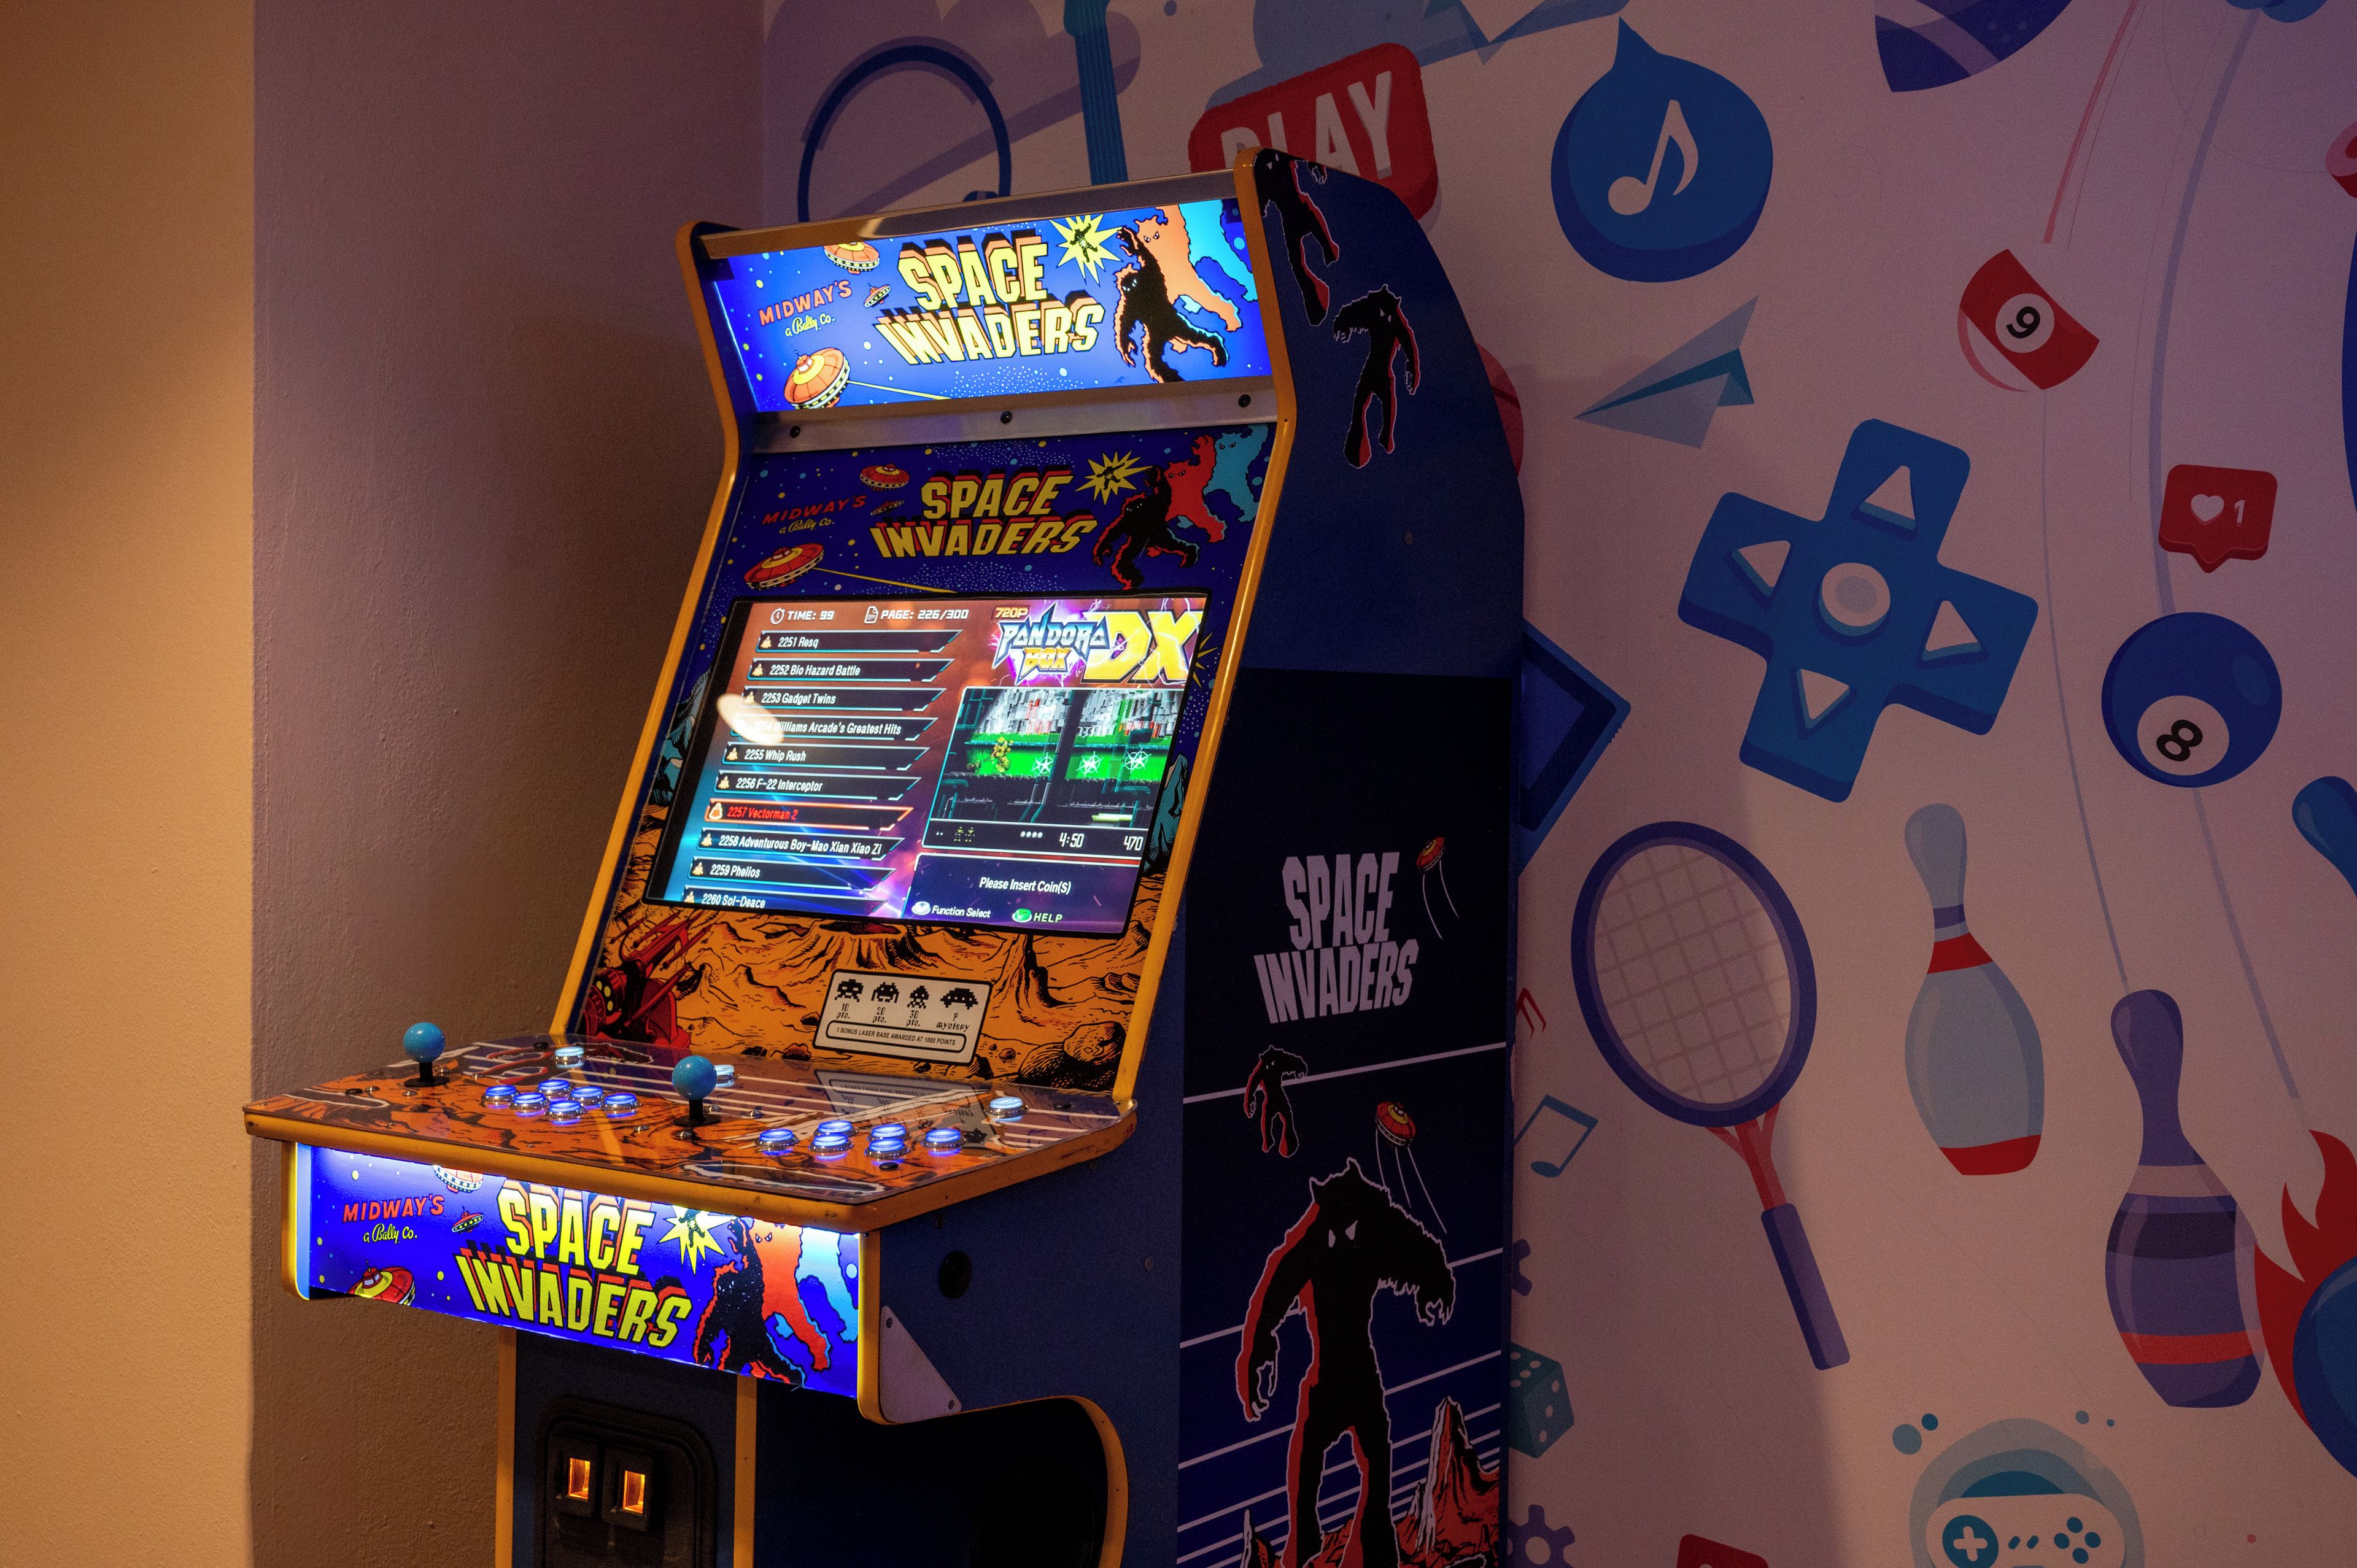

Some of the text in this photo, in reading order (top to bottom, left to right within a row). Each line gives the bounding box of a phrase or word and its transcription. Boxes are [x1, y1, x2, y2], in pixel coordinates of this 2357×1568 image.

[897, 238, 1048, 311] SPACE
[758, 279, 853, 326] MIDWAY'S
[785, 312, 835, 337] a Bally Co.
[872, 298, 1105, 365] INVADERS
[921, 473, 1072, 520] SPACE
[762, 495, 867, 525] MIDWAY'S
[788, 519, 817, 533] Bally
[869, 516, 1097, 558] INVADERS
[788, 610, 835, 620] TIME: 99
[881, 609, 969, 620] PAGE: 226/300
[995, 607, 1029, 618] 720P
[778, 637, 819, 649] 2251 Resq
[1080, 609, 1203, 684] DX
[770, 665, 861, 676] 2252 Bio Hazard Battle
[1019, 647, 1072, 679] BOX
[761, 692, 836, 706] 2253 Gadget Twins
[774, 721, 807, 732] Williams
[808, 722, 845, 733] Arcade's
[847, 723, 884, 734] Greatest
[884, 724, 902, 735] Hits
[2156, 719, 2204, 762] 8
[744, 749, 806, 762] 2255 Whip Rush
[736, 778, 823, 793] 2256 F-22 Interceptor
[727, 807, 798, 821] 2257 Vectorman 2
[718, 835, 882, 854] 2258 Adventurous Boy-Mao Xian Xiao Zi
[1059, 832, 1085, 848] 4:50
[1124, 835, 1144, 851] 470
[710, 864, 761, 878] 2259 Phelios
[979, 878, 1071, 895] Please Insert Coin(S)
[702, 894, 765, 908] 2260 Sol-Deace
[1282, 852, 1399, 950] SPACE
[932, 905, 991, 918] Function Select
[1034, 912, 1062, 923] HELP
[1254, 939, 1418, 1024] INVADERS
[906, 1018, 921, 1027] pts.
[910, 1010, 919, 1019] 30
[936, 1021, 970, 1032] mystery
[891, 1032, 916, 1041] AWARDED
[343, 1194, 444, 1223] MIDWAY'S
[363, 1223, 417, 1244] a Bally Co.
[497, 1184, 656, 1274] SPACE
[455, 1252, 692, 1348] INVADERS
